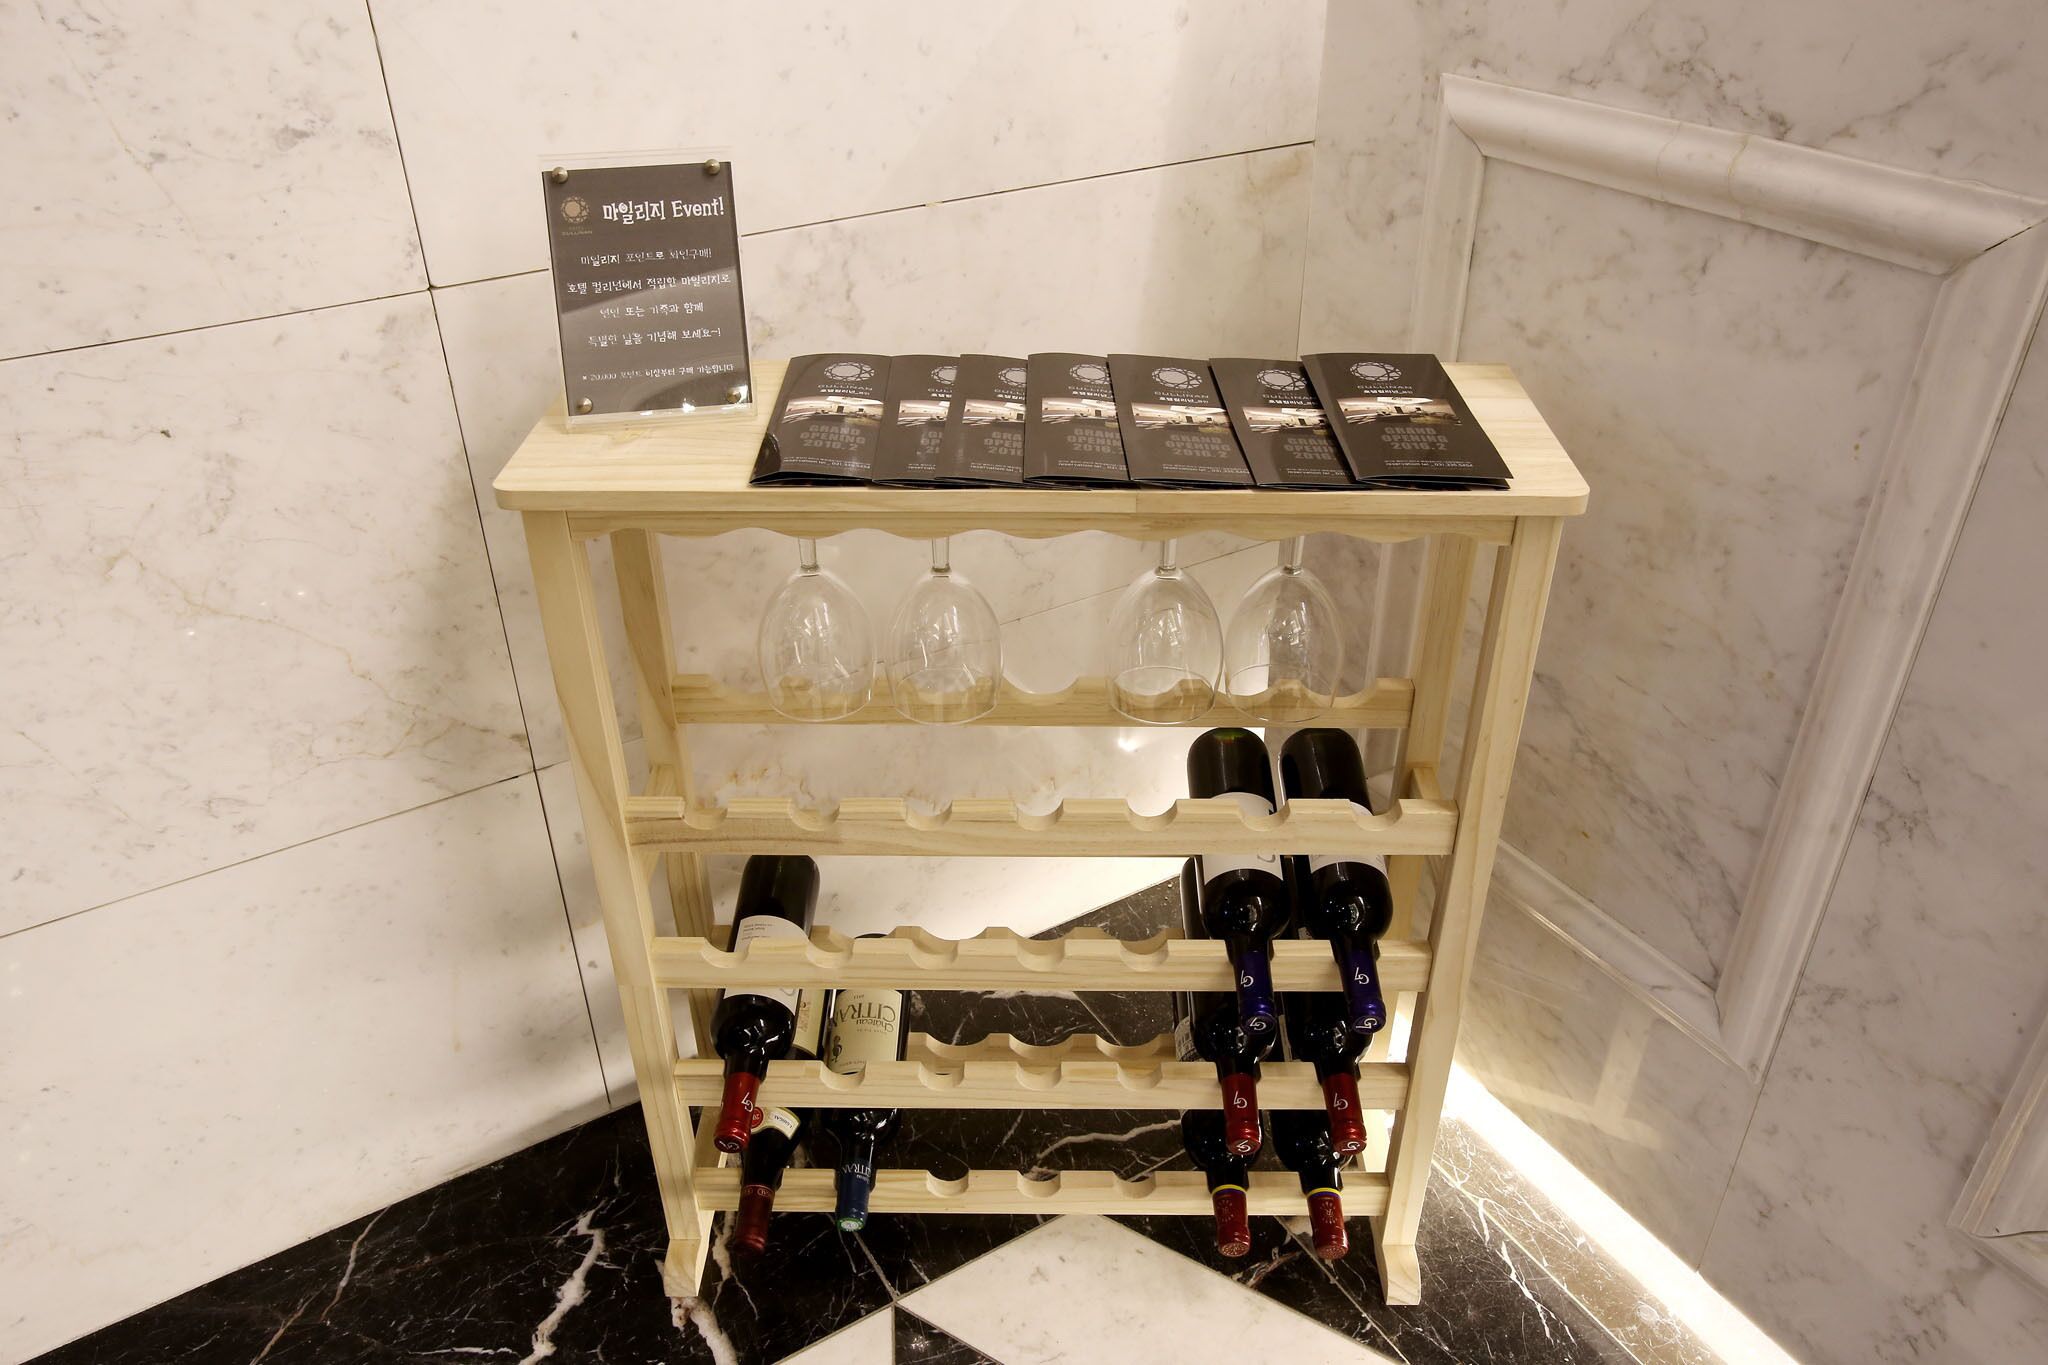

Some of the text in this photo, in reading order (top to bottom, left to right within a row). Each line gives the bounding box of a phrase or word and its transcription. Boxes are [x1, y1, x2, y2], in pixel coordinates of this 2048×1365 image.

[602, 196, 724, 225] 마일리지 Event!
[580, 253, 620, 267] 마일리지
[567, 274, 731, 295] 호텔 컬리넌에서 적립한 마일리지로
[625, 305, 645, 317] 또는
[651, 303, 679, 315] 가족과
[683, 302, 704, 314] 함께
[588, 334, 617, 347] 특별한
[647, 330, 677, 342] 기념해
[645, 368, 675, 378] 이상부터
[679, 366, 694, 375] 구매
[697, 363, 735, 374] 가능합니다
[809, 425, 861, 435] GRAND
[800, 432, 866, 444] OPENING
[1169, 434, 1222, 444] GRAND
[1287, 438, 1331, 446] GRAN
[1381, 434, 1448, 442] OPENING
[1165, 440, 1231, 451] OPENING
